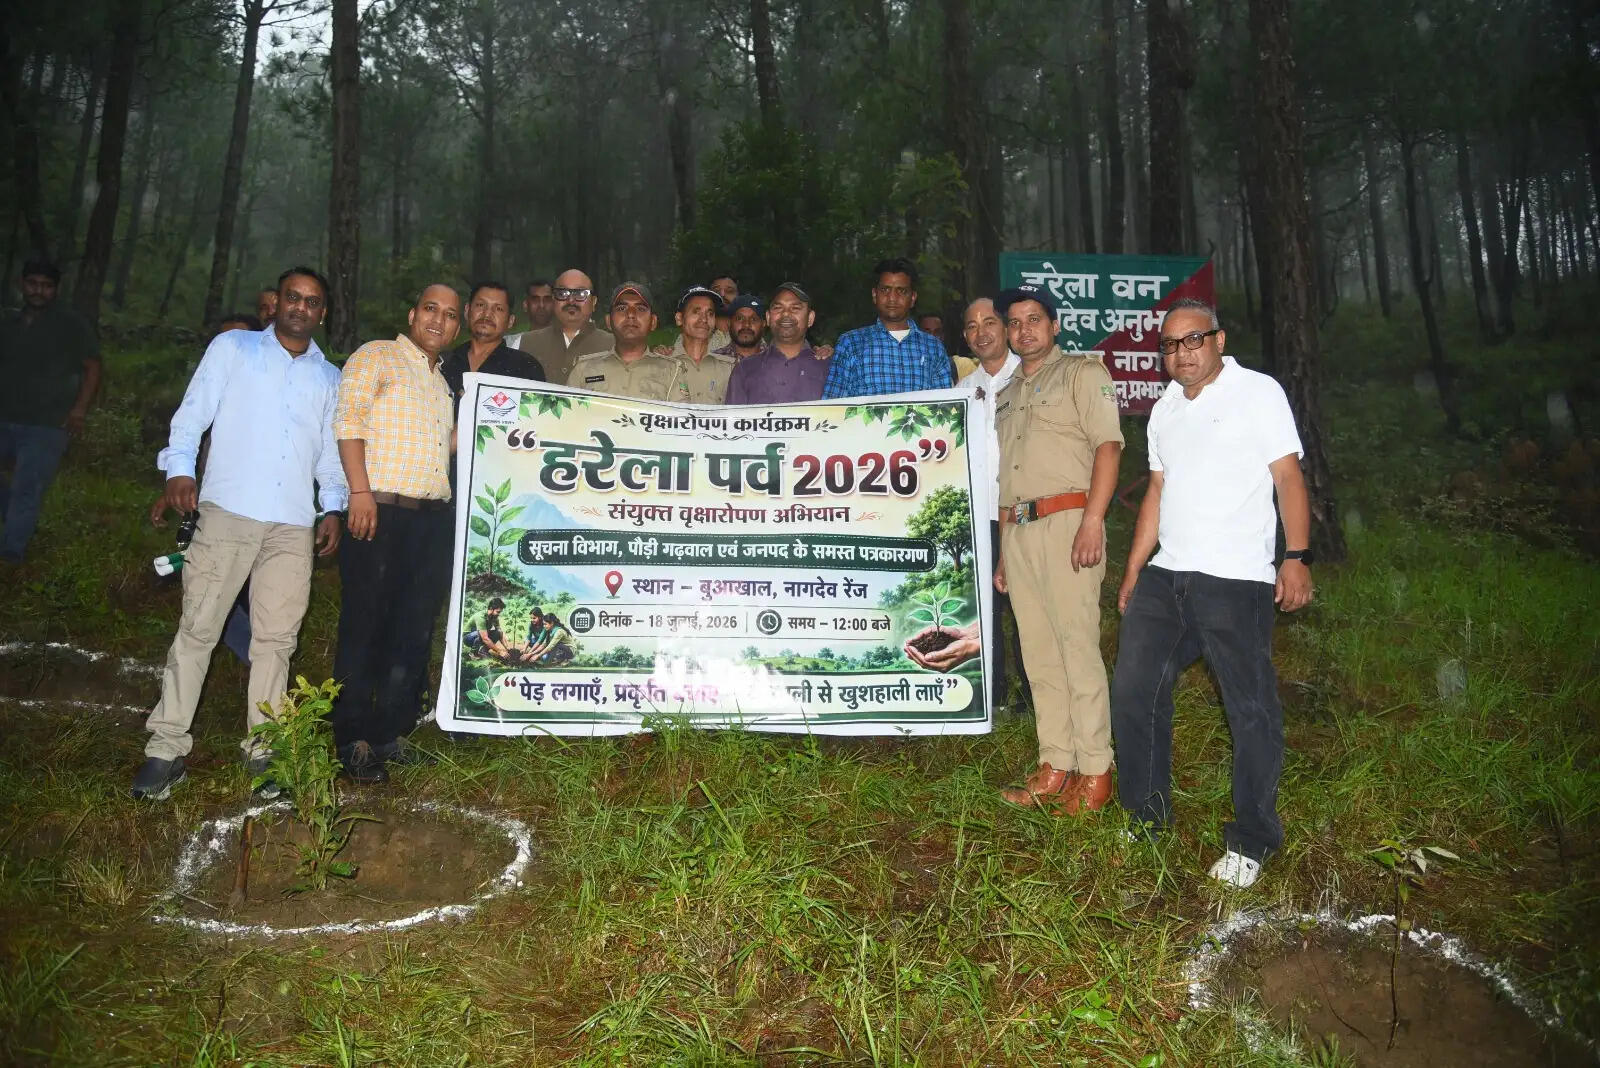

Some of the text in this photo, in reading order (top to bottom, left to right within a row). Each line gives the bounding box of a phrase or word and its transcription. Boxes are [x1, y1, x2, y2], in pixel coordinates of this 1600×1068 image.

[1110, 274, 1169, 300] वन
[1101, 307, 1166, 342] अनुभ
[639, 412, 811, 433] वृक्षारोपण कार्यक्रम
[705, 442, 786, 496] पर्व
[608, 499, 850, 528] संयुक्त वृक्षारोपण अभियान
[529, 535, 929, 563] सूचना विभाग, पौड़ी गढ़वाल एवं जनपद के समस्त पत्रकारगण
[632, 578, 674, 595] स्थान
[699, 580, 777, 600] बुआखाल,
[783, 576, 838, 599] नागदेव
[843, 577, 868, 599] रेंज
[599, 611, 632, 628] दिनांक
[649, 615, 663, 628] 18
[706, 615, 737, 629] 2026
[788, 617, 816, 630] समय
[833, 617, 867, 631] 12:00
[871, 615, 891, 631] बजे
[551, 677, 608, 705] लगाएँ,
[614, 678, 666, 709] प्रकृति
[818, 680, 833, 703] से
[838, 679, 910, 709] खुशहाली
